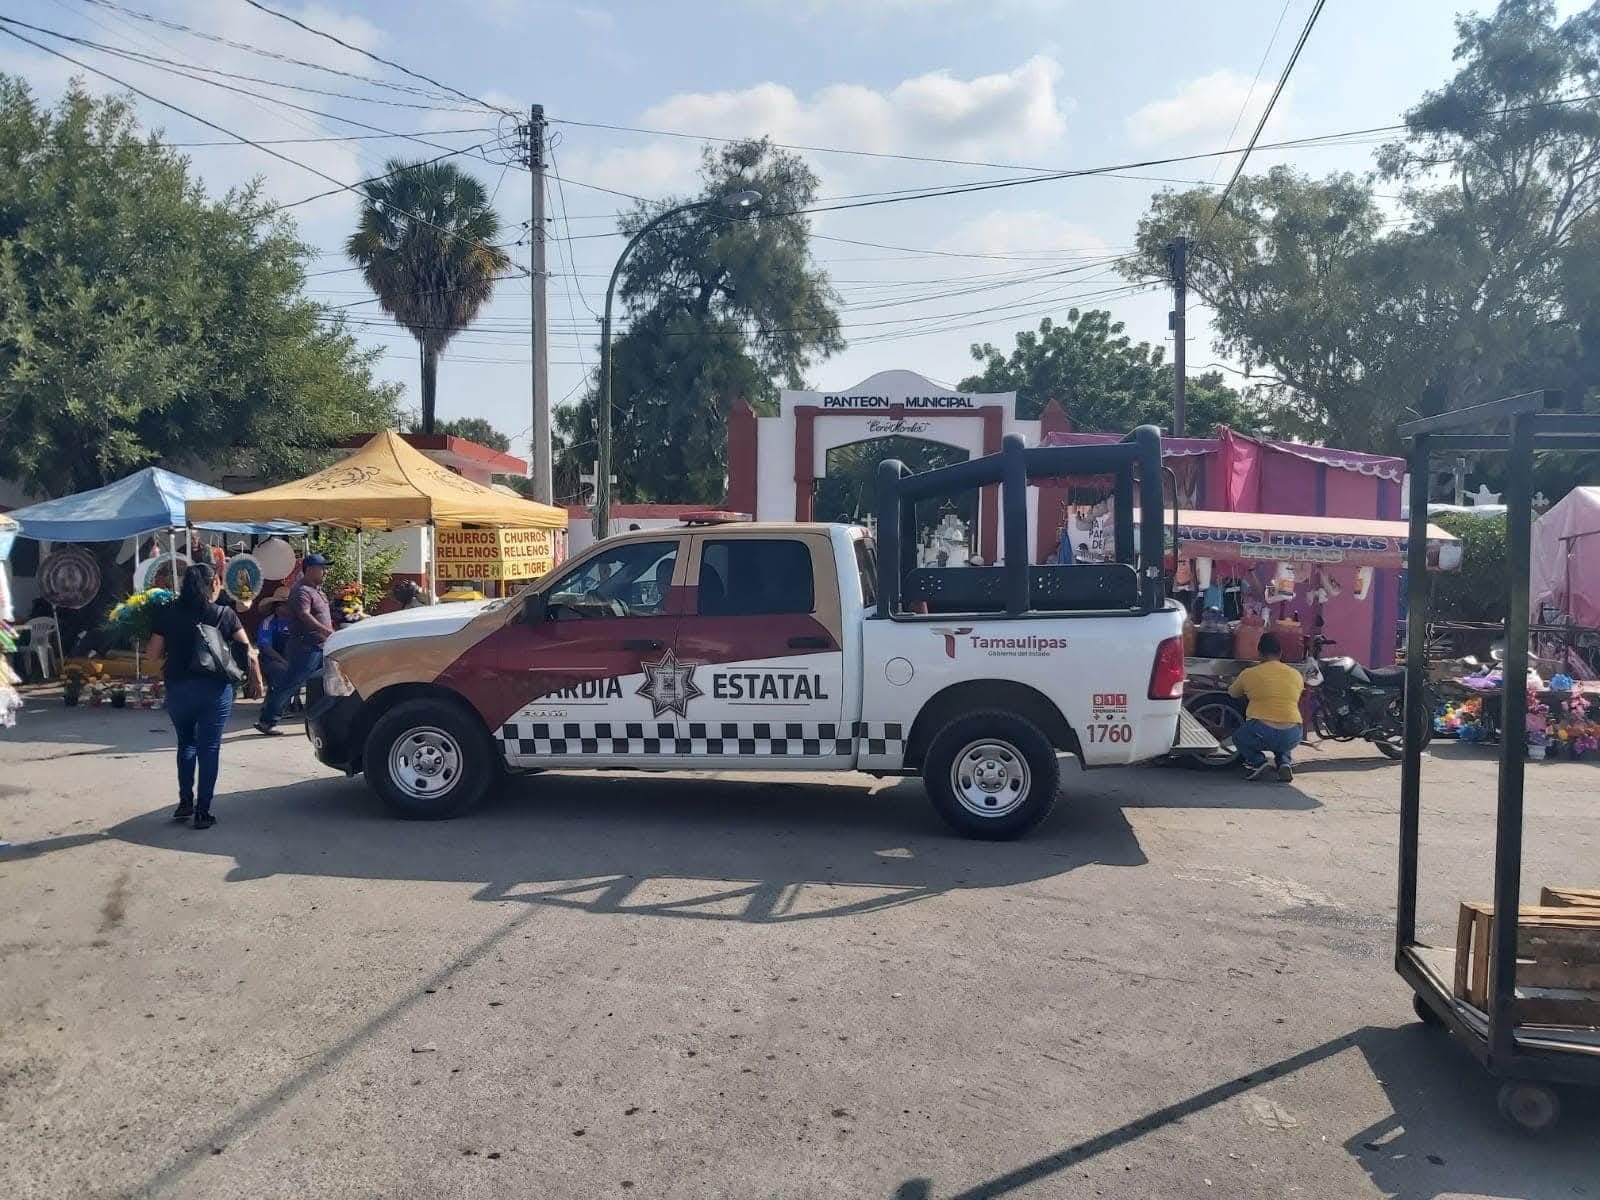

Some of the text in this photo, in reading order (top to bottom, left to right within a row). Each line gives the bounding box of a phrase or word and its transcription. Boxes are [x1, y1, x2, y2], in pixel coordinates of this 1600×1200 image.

[824, 396, 975, 408] PANTEON MUNICIPAL
[438, 532, 497, 545] CHURROS
[504, 531, 547, 544] CHURROS
[1177, 526, 1263, 543] AGUAS
[1269, 531, 1388, 551] FRESCAS
[437, 546, 499, 559] RELLENOS
[504, 544, 550, 558] RELLENOS
[438, 564, 490, 578] EL TIGRE
[511, 561, 546, 576] EL TIGRE
[969, 635, 1067, 651] Tamaulipas
[540, 673, 829, 700] ARDIA ESTATAL
[1093, 695, 1127, 705] 911
[1087, 724, 1132, 743] 1760
